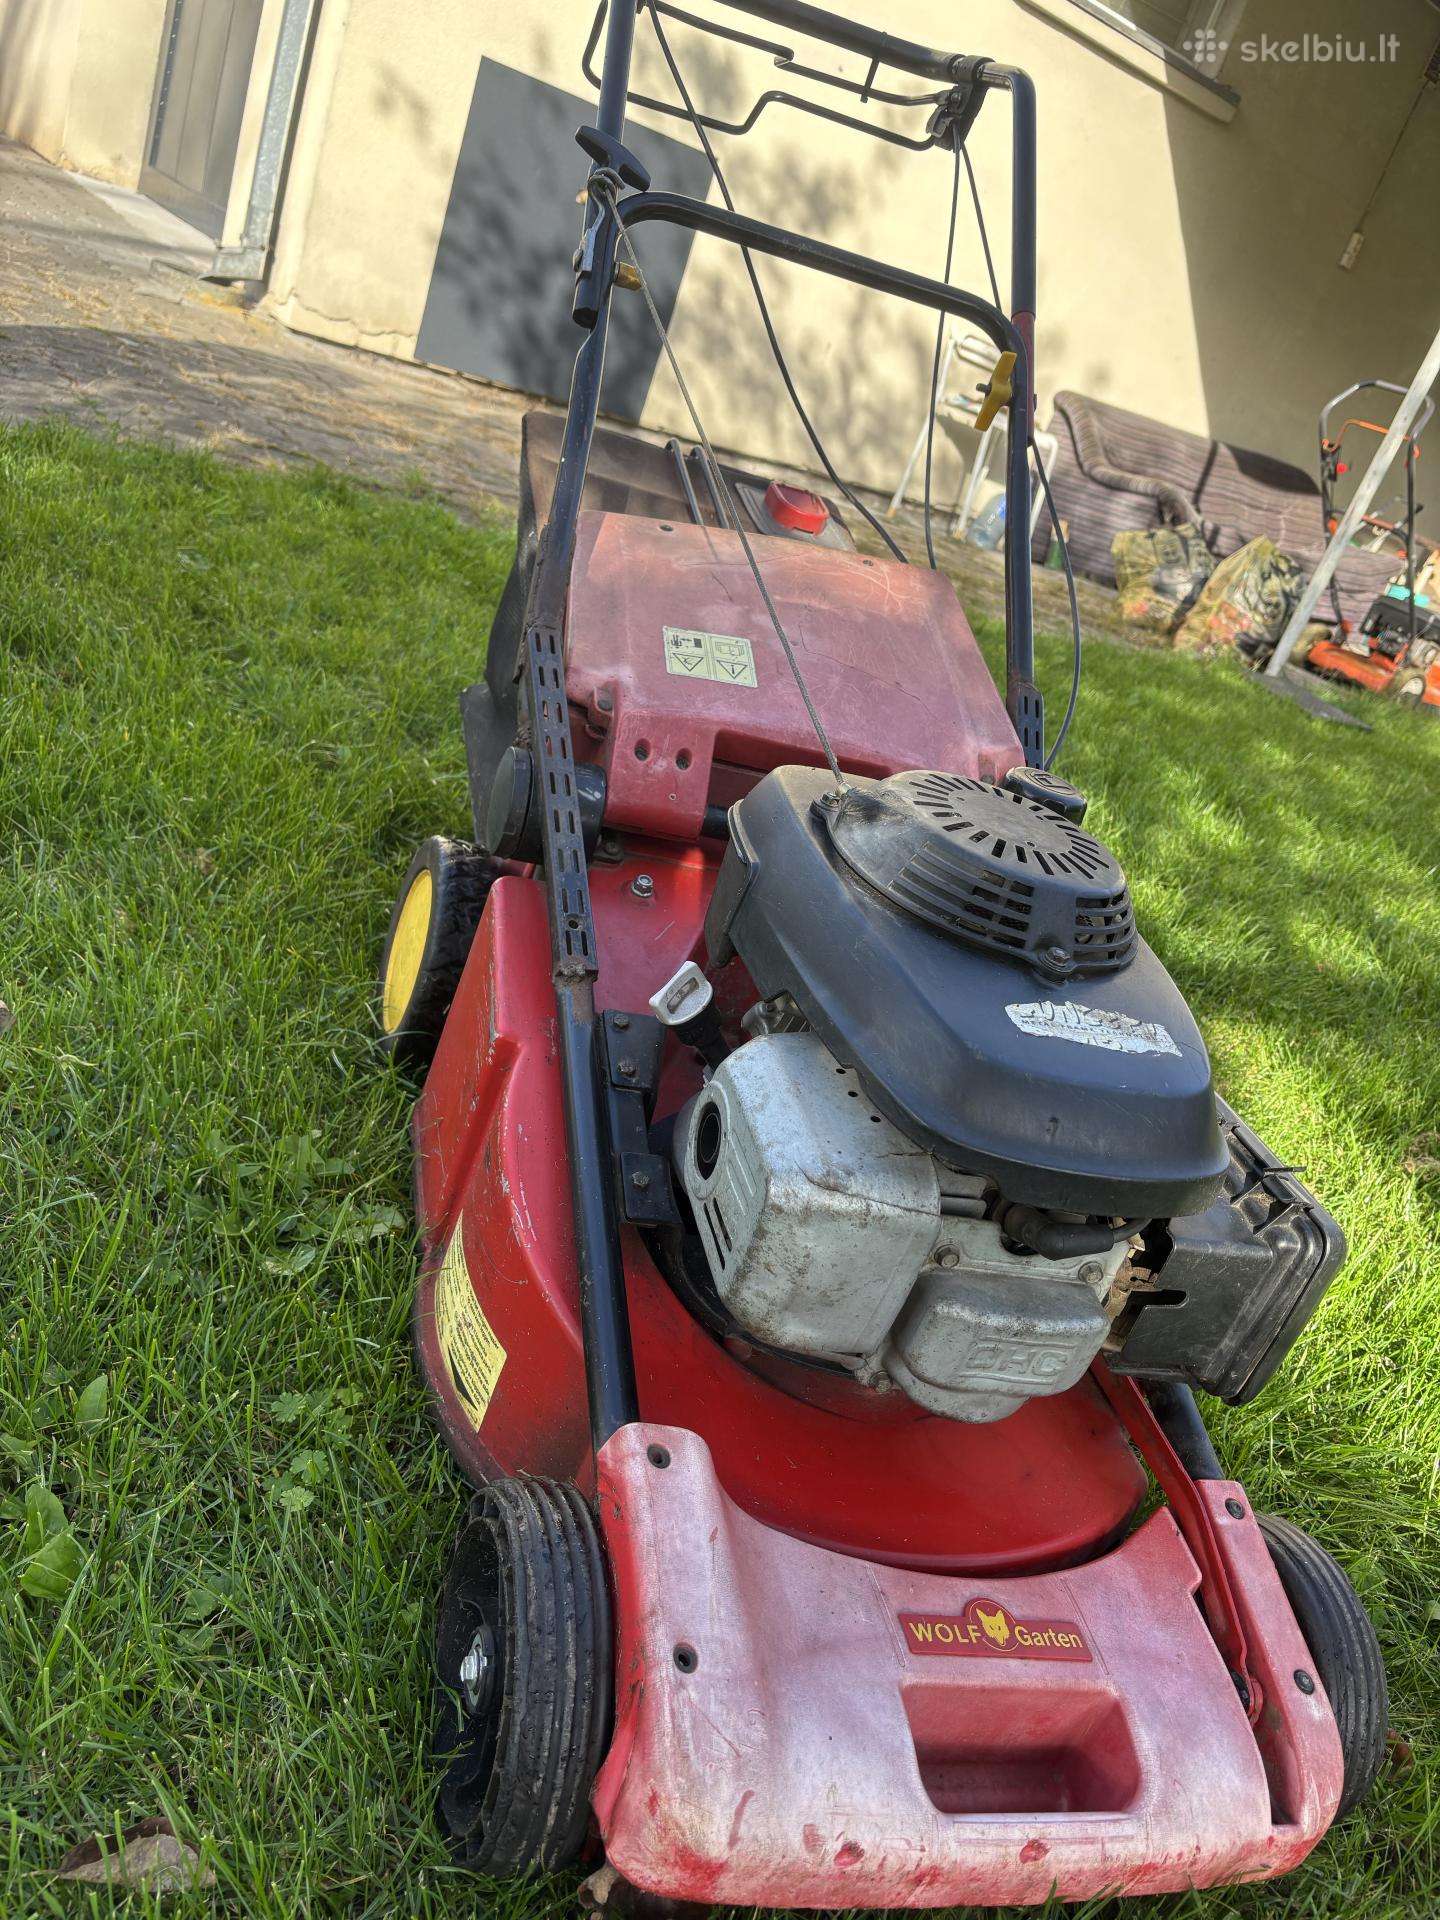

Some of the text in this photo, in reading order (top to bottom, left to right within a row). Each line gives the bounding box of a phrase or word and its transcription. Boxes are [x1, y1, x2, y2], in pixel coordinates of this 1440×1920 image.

[965, 1344, 1068, 1376] OHC
[908, 1622, 1083, 1648] WOLF Garten
